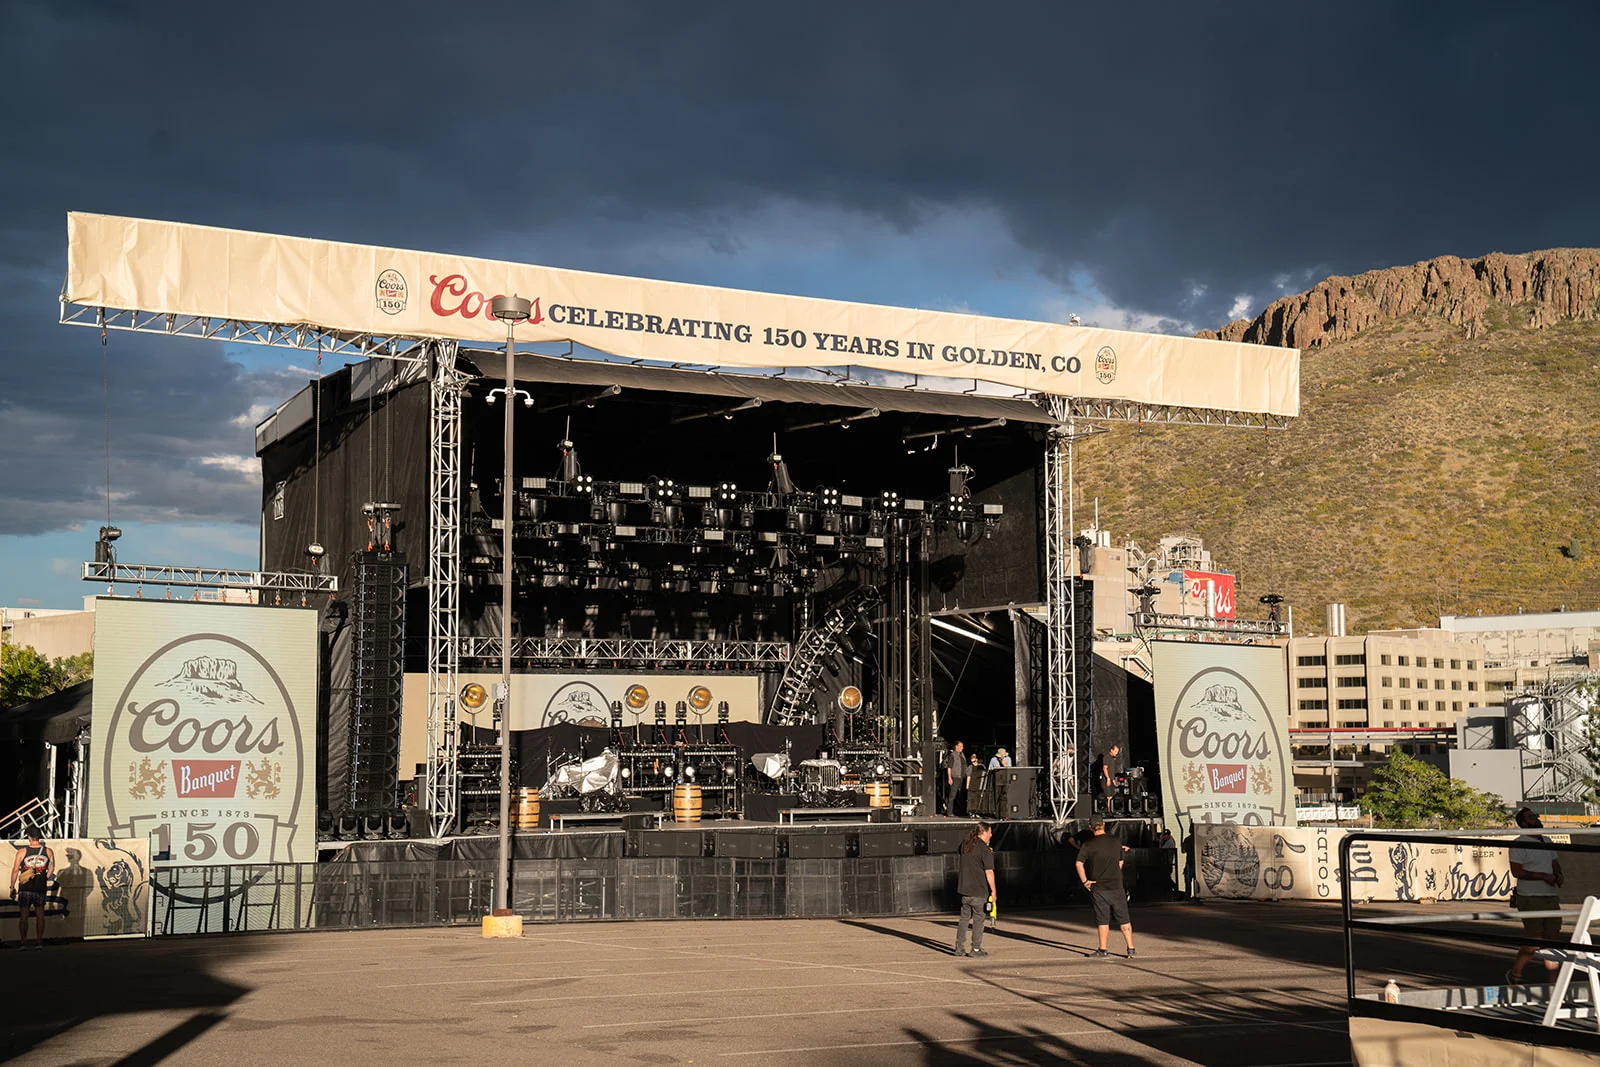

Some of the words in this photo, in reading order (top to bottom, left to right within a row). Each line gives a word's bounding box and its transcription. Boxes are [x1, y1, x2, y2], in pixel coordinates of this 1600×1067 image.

[383, 300, 401, 309] 150
[429, 274, 545, 324] Cos
[548, 304, 753, 344] CELEBRATING
[763, 327, 807, 349] 150
[812, 332, 900, 358] YEARS
[906, 341, 935, 361] IN
[941, 345, 1047, 373] GOLDEN,
[1051, 355, 1082, 374] CO
[127, 698, 285, 754] Coors
[1176, 716, 1272, 760] Coors
[180, 764, 236, 795] Banquet
[1211, 767, 1245, 790] Banquet
[160, 809, 209, 819] SINCE
[217, 809, 251, 818] 1873
[1204, 801, 1233, 809] SINCE
[1237, 802, 1257, 810] 1873
[151, 822, 260, 861] 150
